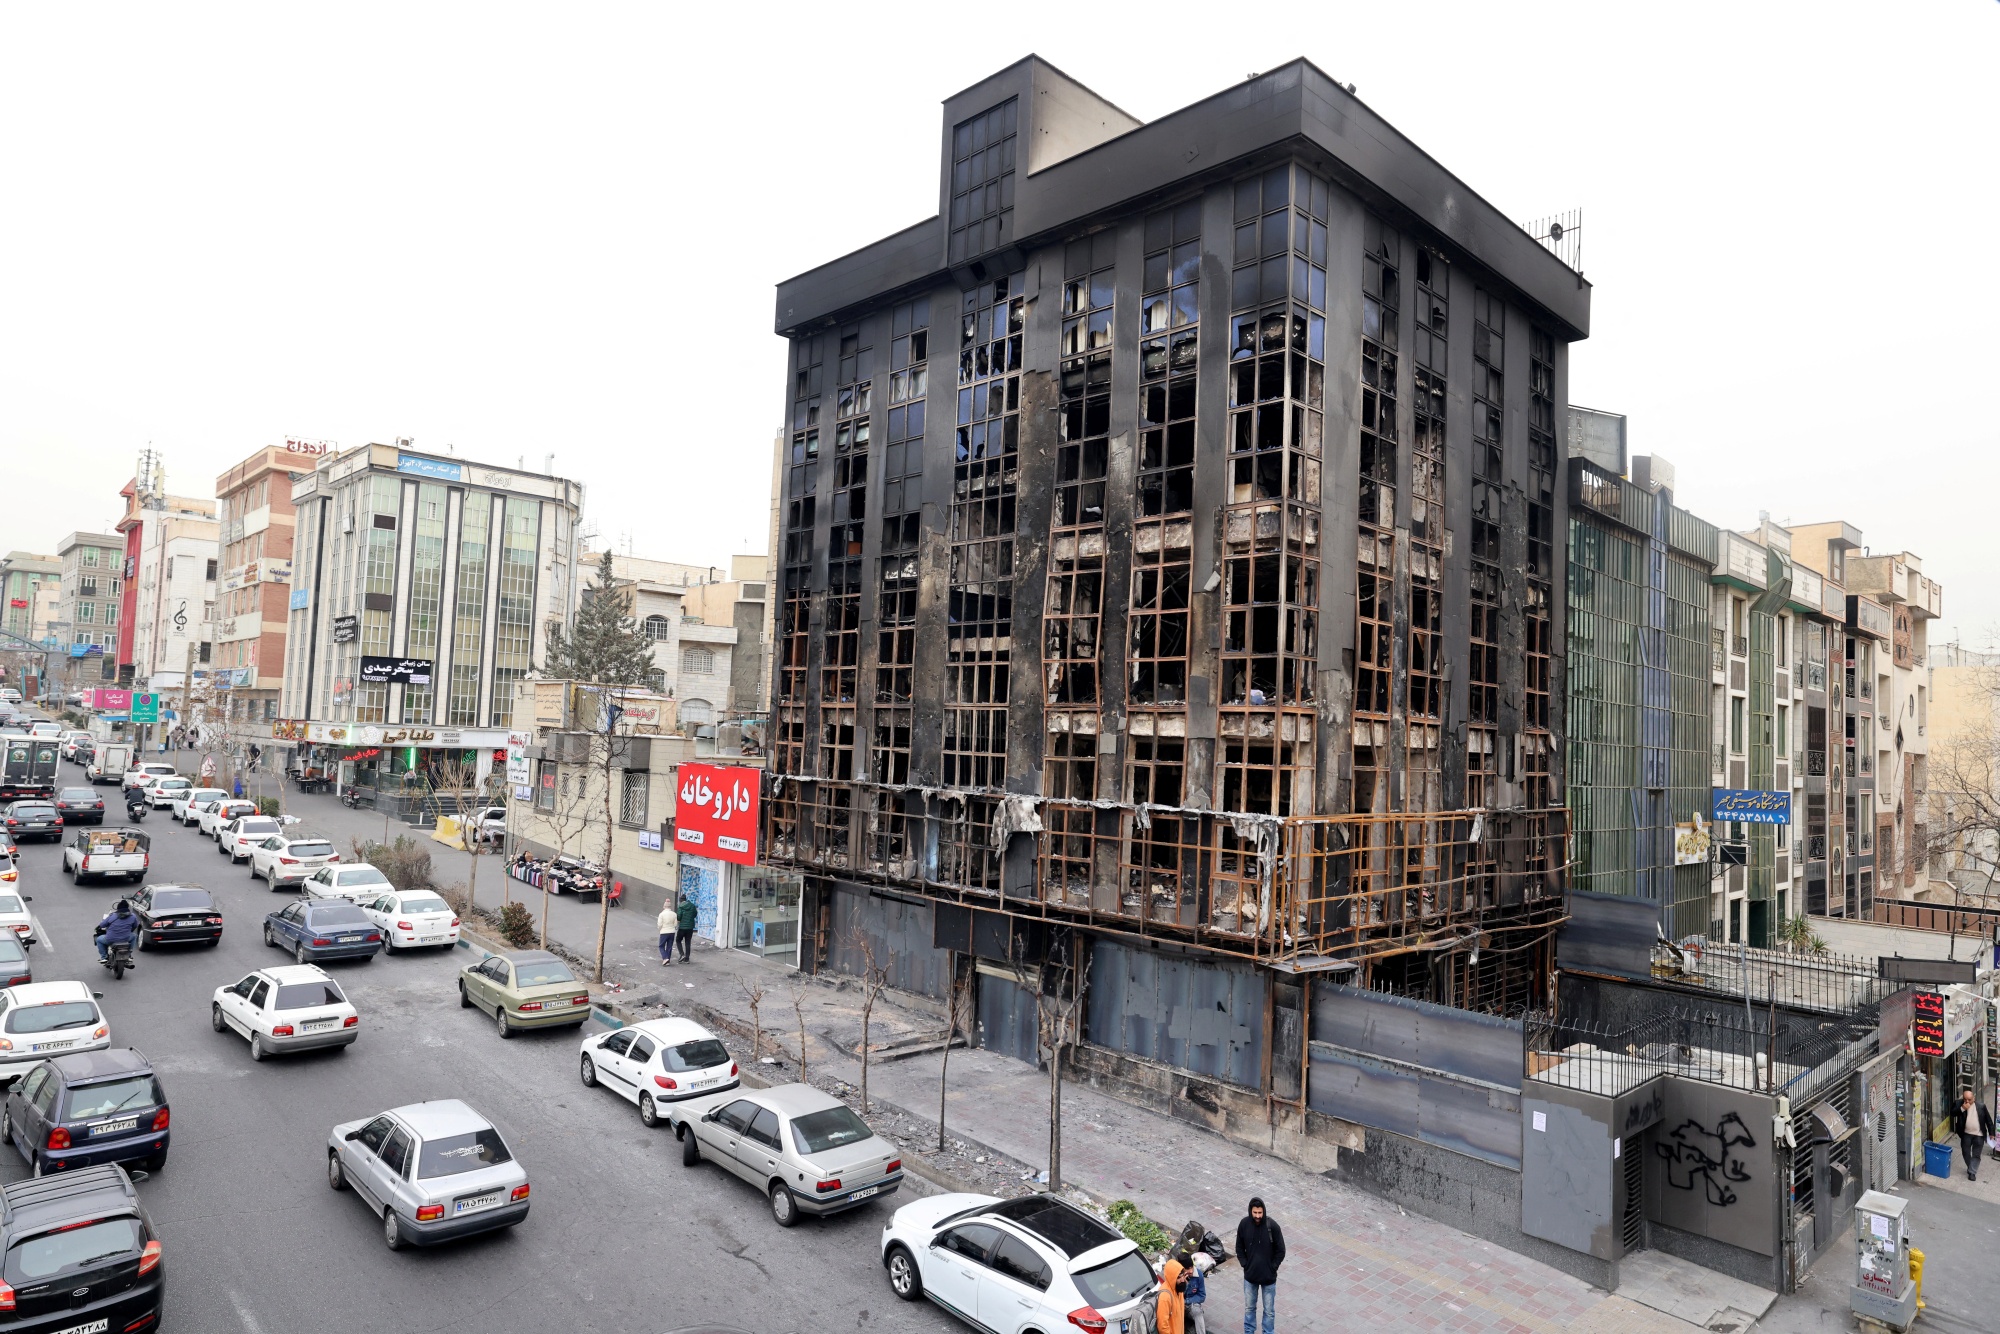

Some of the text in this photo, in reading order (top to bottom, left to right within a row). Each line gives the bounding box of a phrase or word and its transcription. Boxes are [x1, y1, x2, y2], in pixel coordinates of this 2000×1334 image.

[286, 440, 327, 455] ازدواج
[484, 472, 511, 487] ازدواج
[363, 664, 414, 675] سحر عبدی
[624, 707, 657, 721] آزمایشگاه
[382, 728, 435, 744] طباخی
[680, 774, 750, 821] داروخانه
[1726, 792, 1760, 810] موسیقی
[1756, 791, 1790, 810] آموزشگاه
[1716, 811, 1774, 823] ۴۴۴۵۳۵۱۸
[1916, 993, 1942, 1004] چاپ
[1916, 1002, 1942, 1014] پونک
[1916, 1018, 1942, 1027] کپی
[1916, 1025, 1942, 1038] پرینت
[1916, 1035, 1942, 1048] پلات
